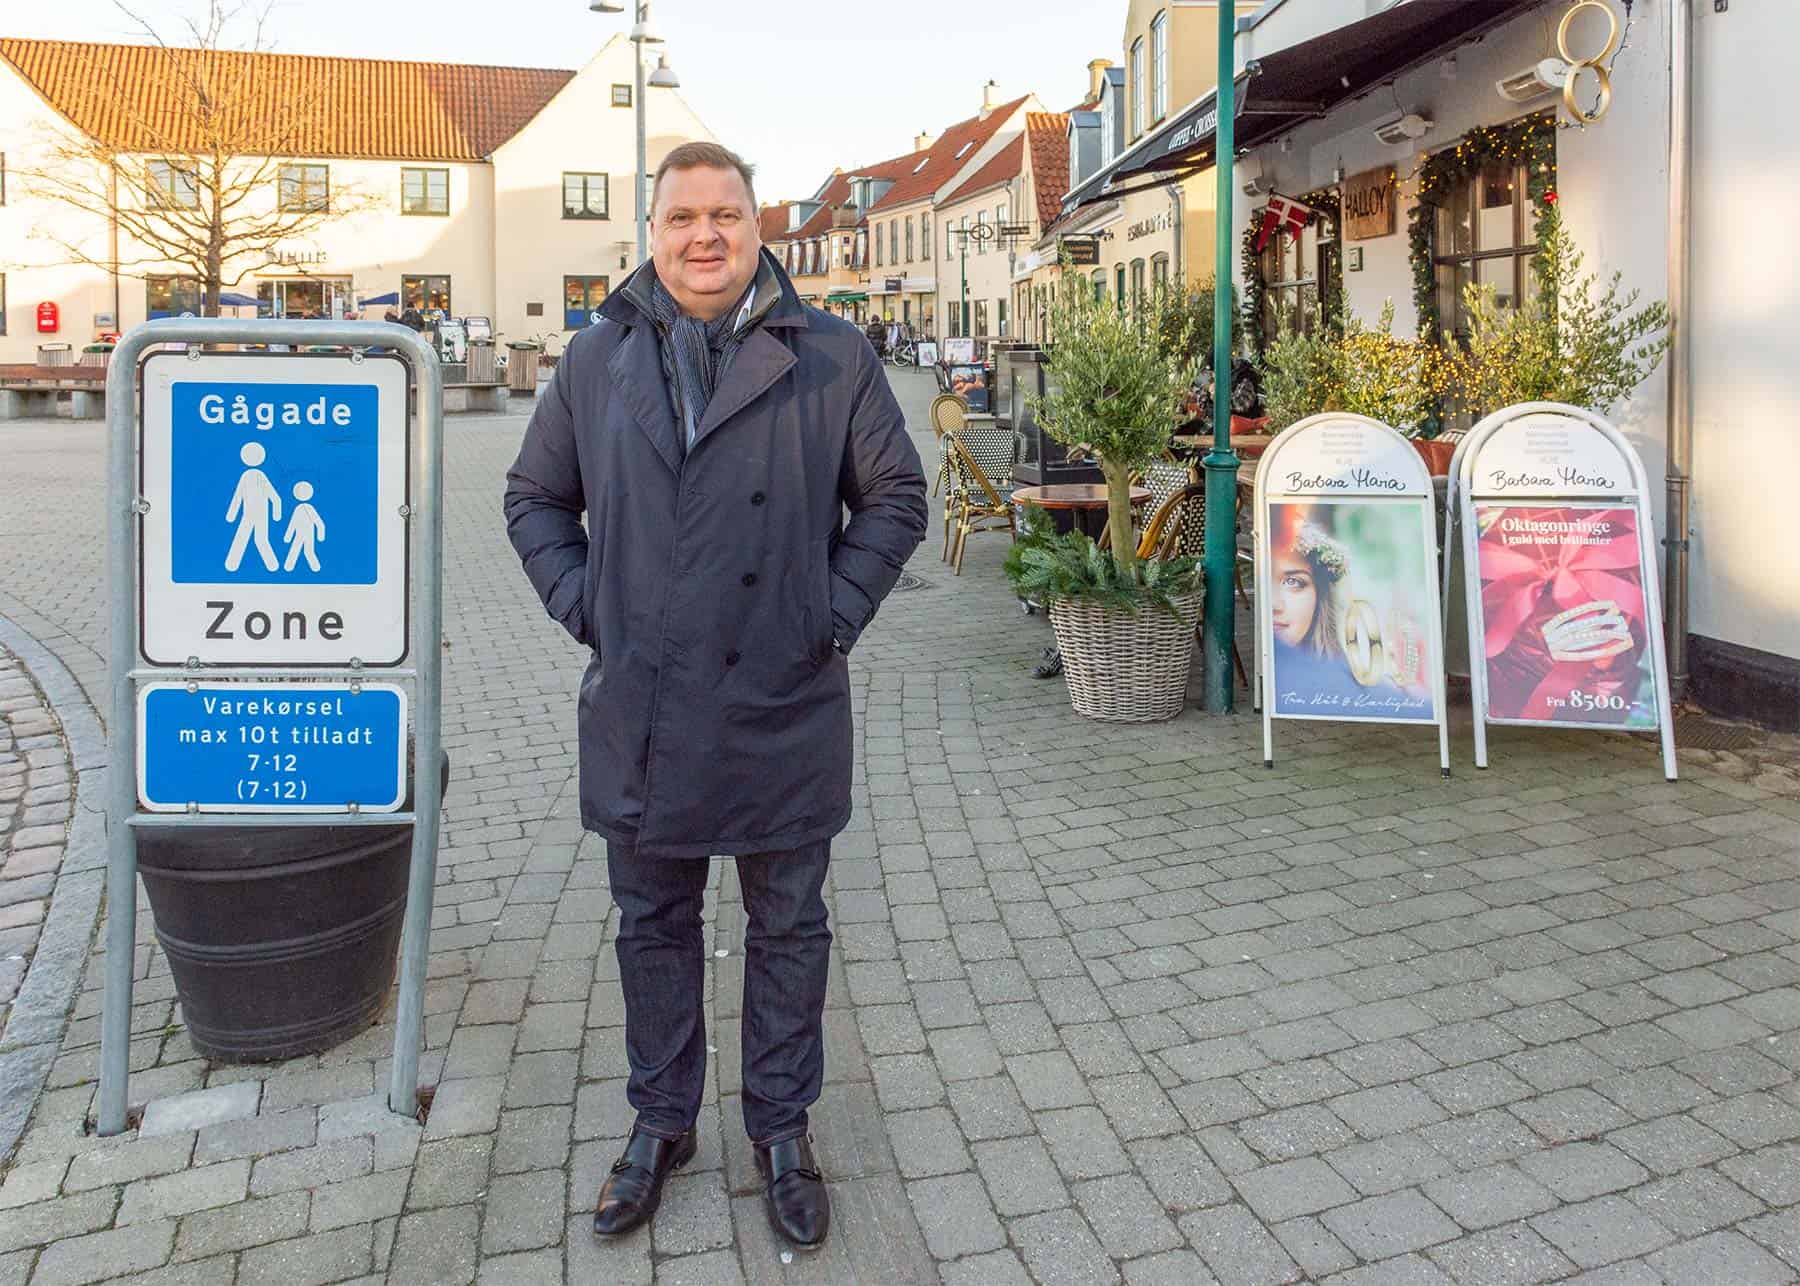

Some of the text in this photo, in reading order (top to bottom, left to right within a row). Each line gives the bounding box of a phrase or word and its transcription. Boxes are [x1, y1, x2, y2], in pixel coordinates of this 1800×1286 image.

[200, 394, 351, 430] Gågade
[1286, 471, 1350, 493] Barbara
[1489, 470, 1555, 491] Barbara
[1501, 517, 1611, 536] Oktagonringe
[1535, 534, 1558, 545] med
[205, 601, 344, 641] Zone
[203, 697, 343, 715] Varekørsel
[1546, 696, 1566, 707] Fra
[179, 726, 373, 745] max 10t tilladt
